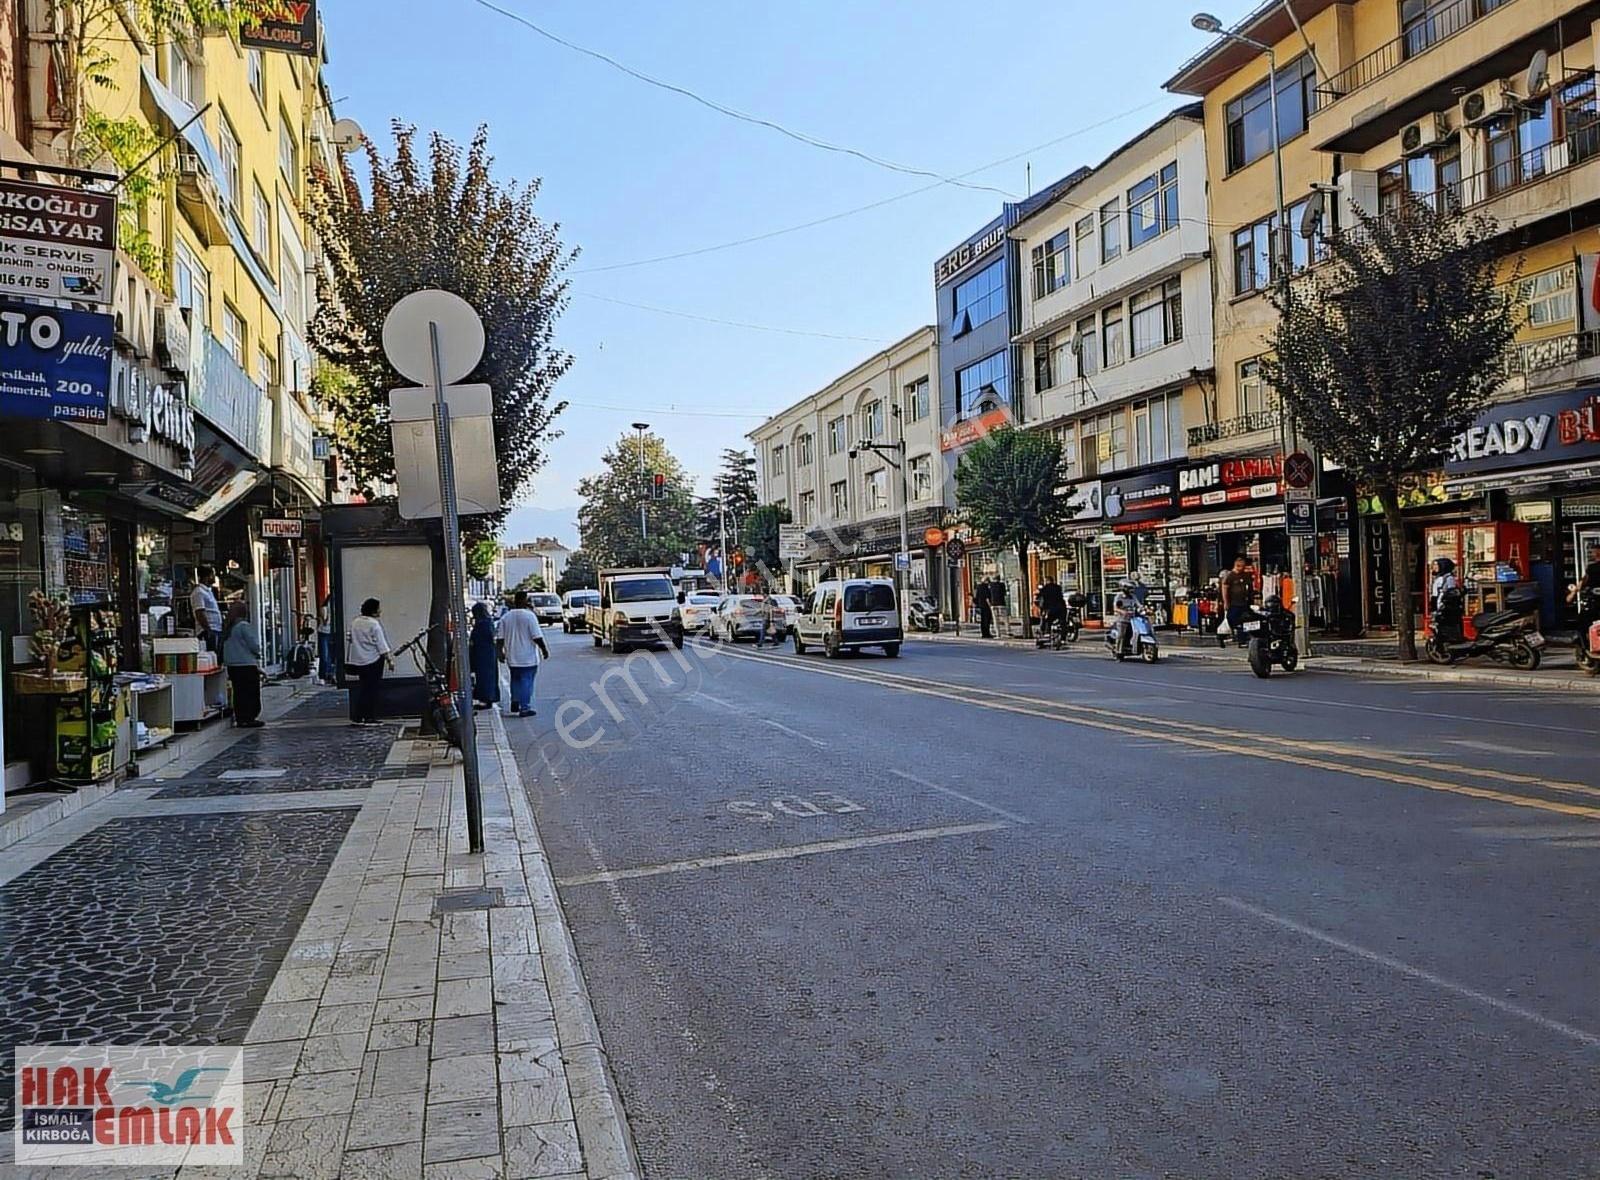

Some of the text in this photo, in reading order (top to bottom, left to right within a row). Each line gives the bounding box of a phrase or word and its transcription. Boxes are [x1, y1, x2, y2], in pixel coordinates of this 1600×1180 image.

[0, 192, 99, 219] KOĞLU
[0, 213, 104, 242] İSAYAR
[973, 225, 1004, 257] GRUP
[0, 273, 50, 289] 16 47 55
[0, 311, 61, 349] TO
[0, 369, 47, 383] esikalık
[56, 380, 92, 396] 200
[53, 404, 106, 419] pasajda
[1448, 414, 1551, 462] READY
[1179, 463, 1220, 492] BAM!
[1371, 520, 1384, 616] OUTLET
